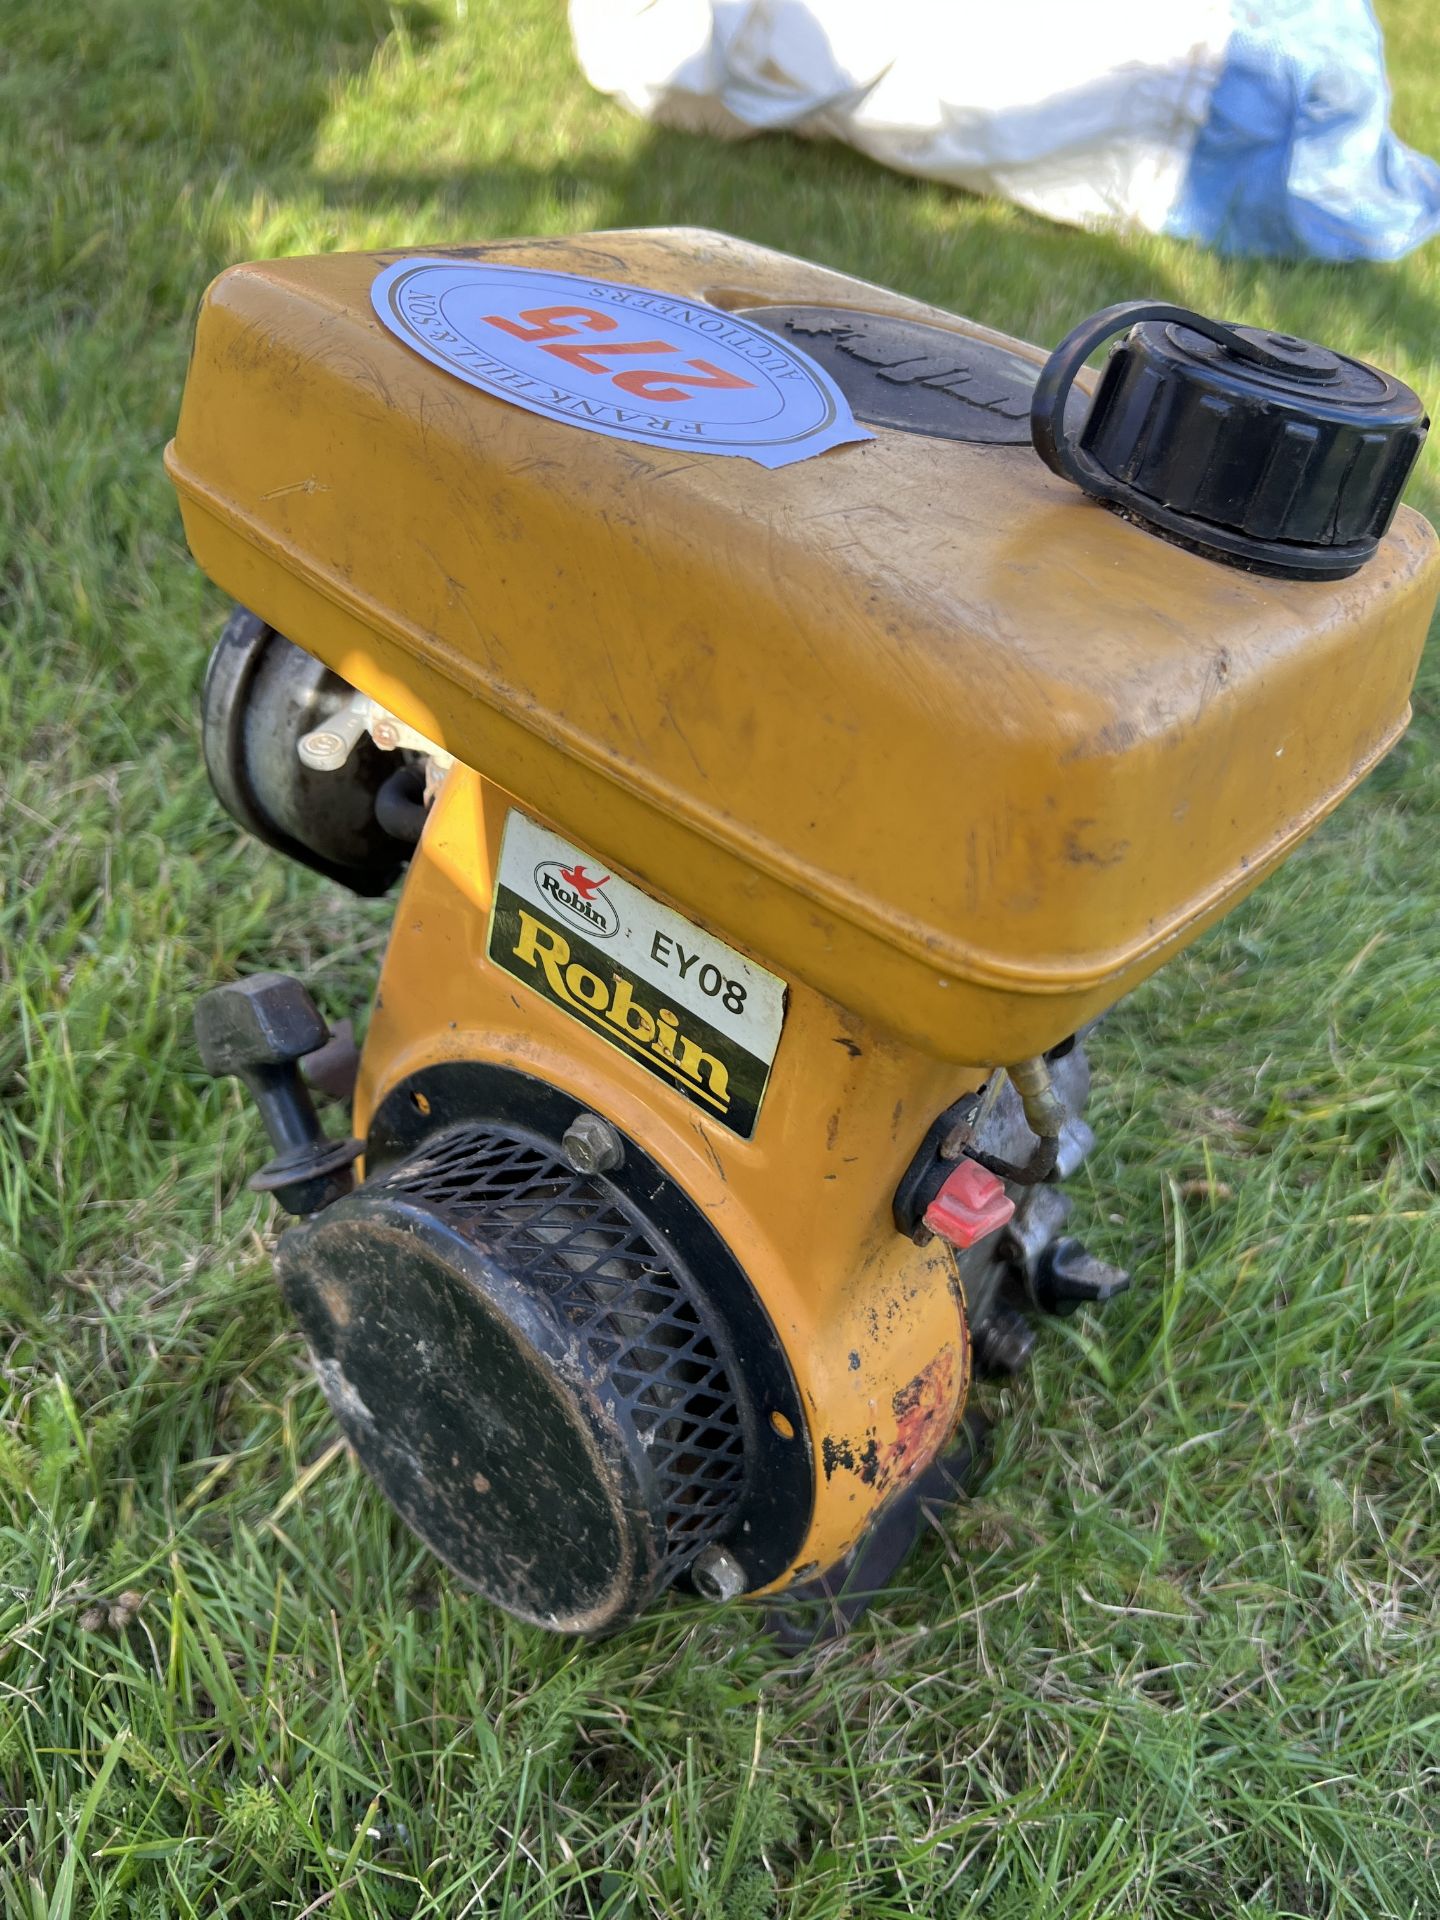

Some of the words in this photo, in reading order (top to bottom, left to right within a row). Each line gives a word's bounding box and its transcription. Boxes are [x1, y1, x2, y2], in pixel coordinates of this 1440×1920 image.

[407, 289, 442, 327] SON
[429, 329, 458, 344] &
[588, 286, 805, 382] AUCTIONEERS
[452, 346, 540, 391] HILL
[480, 305, 759, 403] 275
[537, 389, 707, 436] FRANK
[541, 872, 608, 931] Robin
[649, 929, 748, 1016] EY08
[512, 908, 731, 1106] Robin
